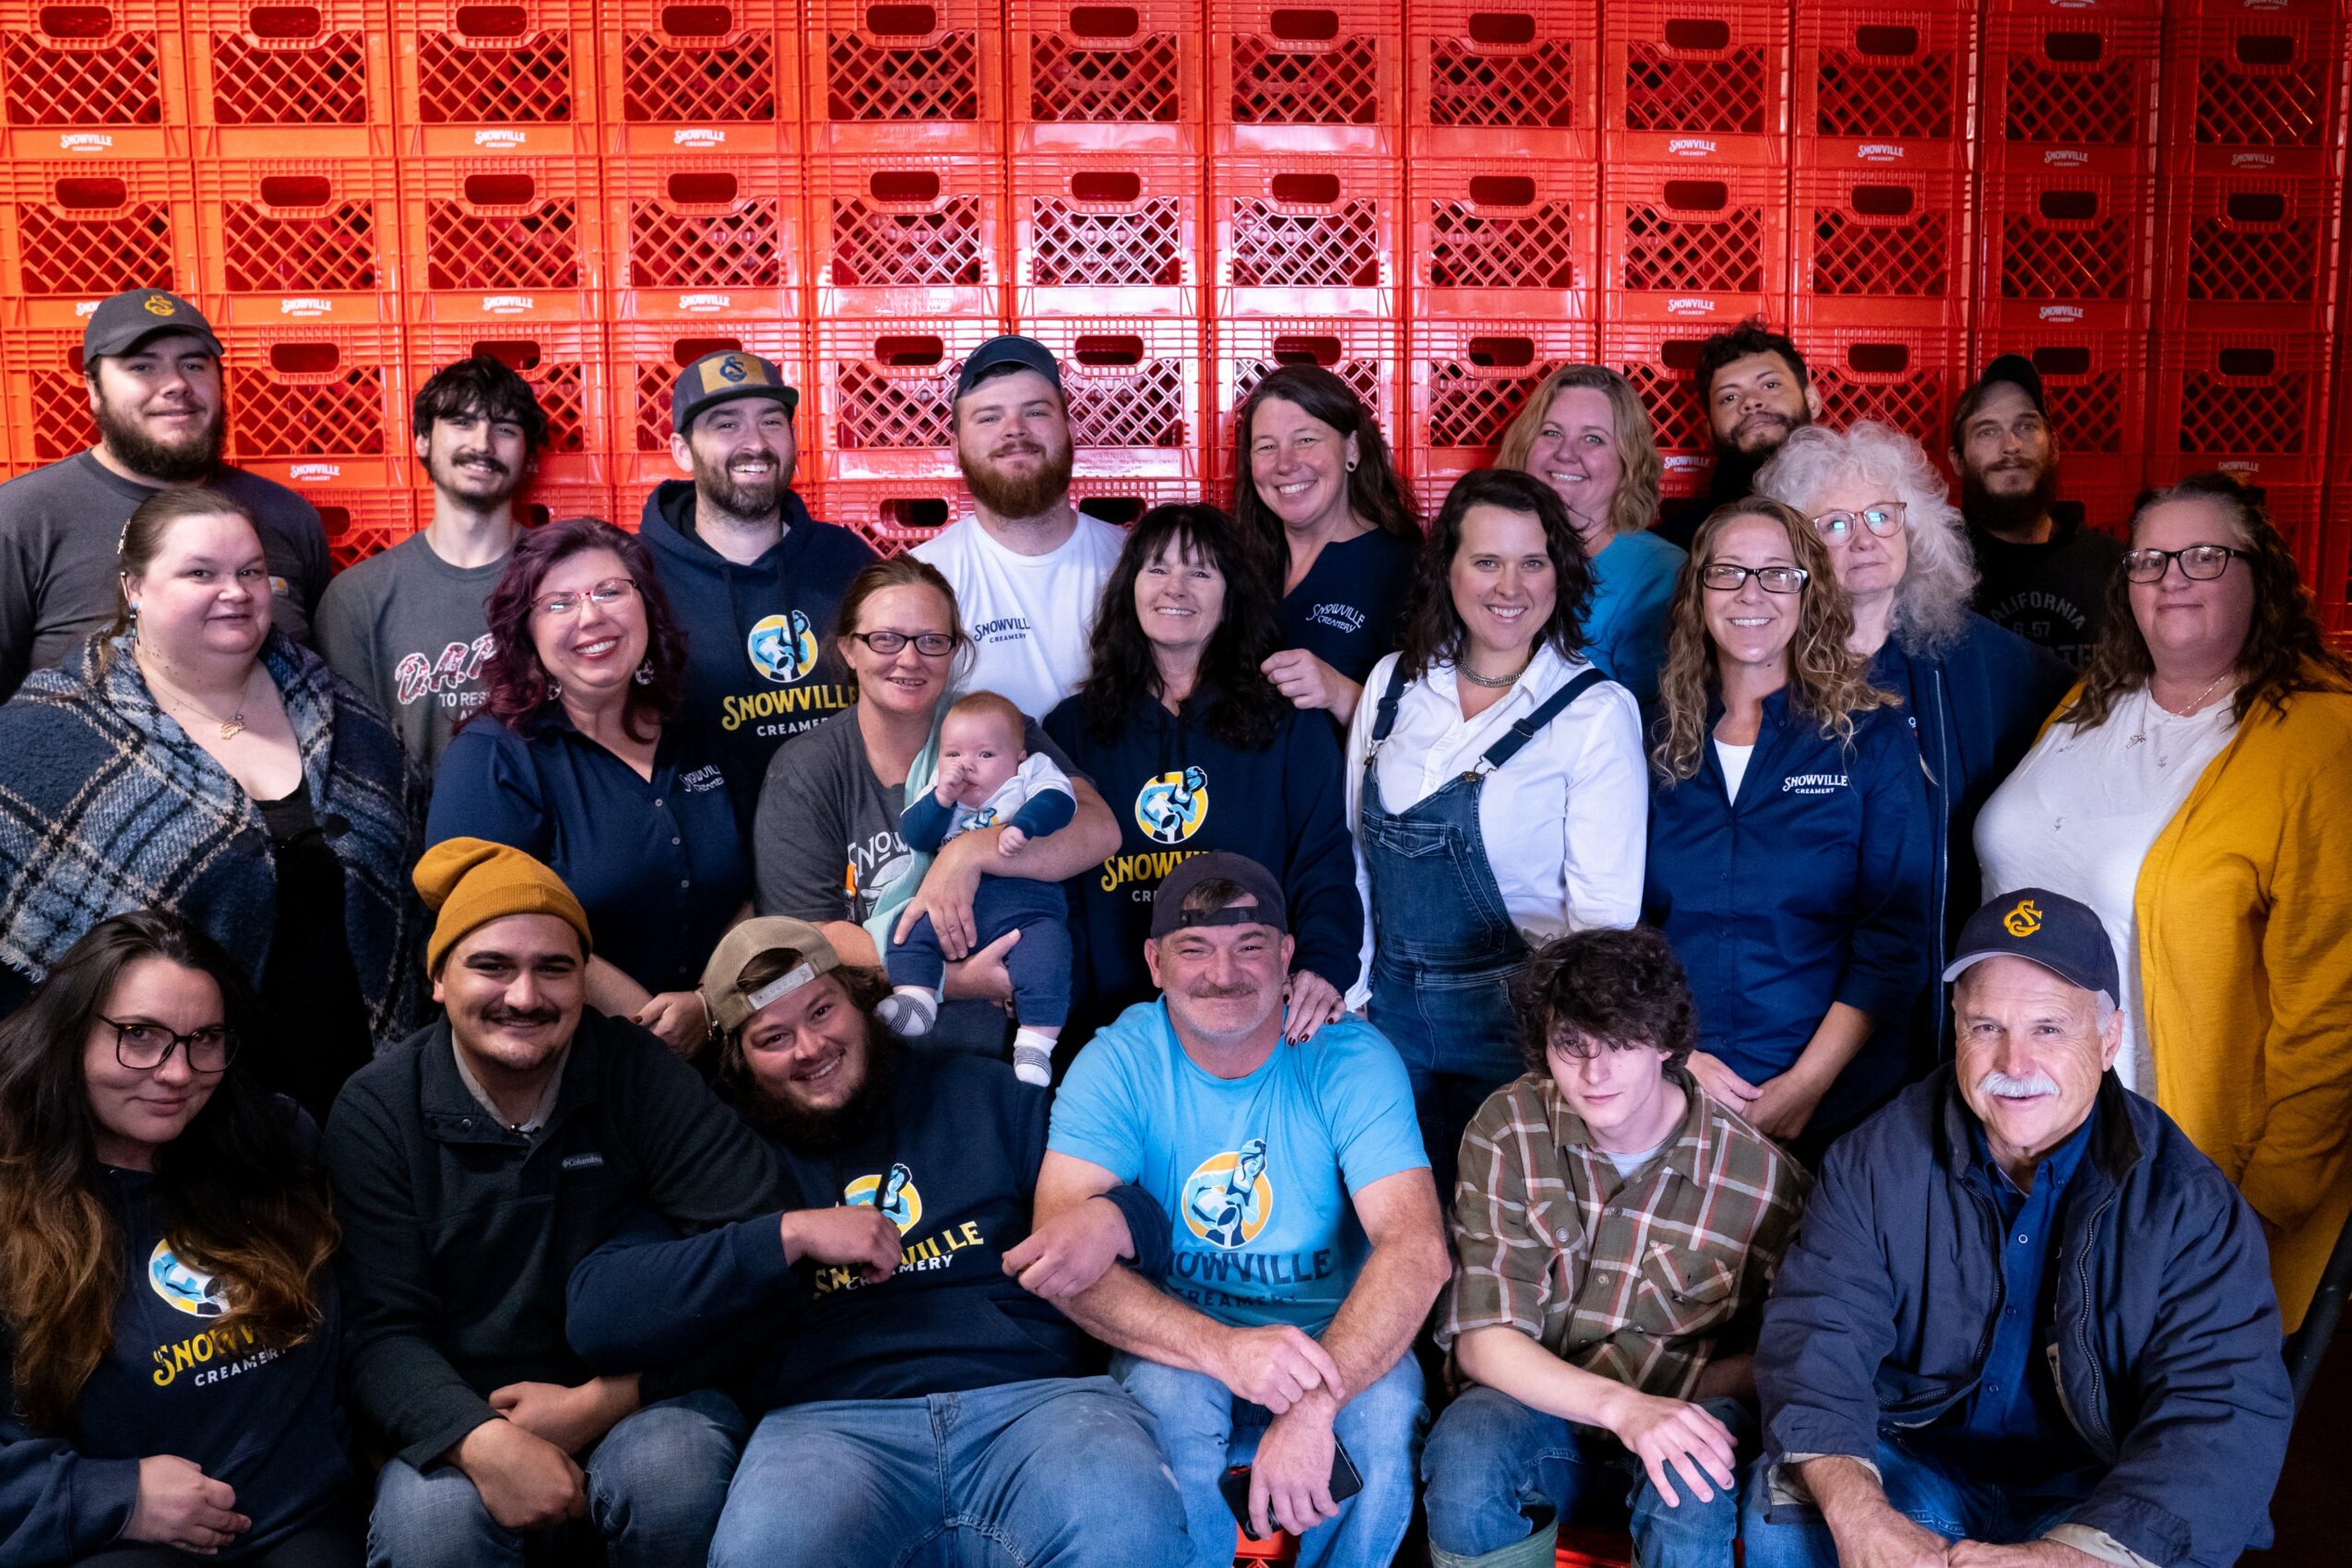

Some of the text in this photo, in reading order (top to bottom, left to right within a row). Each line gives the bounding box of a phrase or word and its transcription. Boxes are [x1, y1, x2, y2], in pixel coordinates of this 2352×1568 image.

[61, 134, 113, 148] SNOWVILLE
[475, 130, 526, 145] SNOWVILLE
[674, 129, 725, 144] SNOWVILLE
[1669, 139, 1716, 153] SNOWVILLE
[1858, 145, 1904, 158] SNOWVILLE
[2044, 150, 2088, 163] SNOWVILLE
[2231, 153, 2275, 166] SNOWVILLE
[281, 298, 332, 314] SNOWVILLE
[482, 296, 533, 311] SNOWVILLE
[679, 294, 730, 309] SNOWVILLE
[1668, 299, 1715, 312] SNOWVILLE
[2039, 305, 2084, 319] SNOWVILLE
[290, 464, 340, 479] SNOWVILLE
[1305, 603, 1365, 629] SNOWVILLE
[1990, 591, 2085, 630] ALIFORNIA
[974, 618, 1030, 642] SNOWVILL
[1317, 614, 1357, 634] CREAMERY
[989, 634, 1027, 643] CREAMERY
[438, 691, 491, 707] TO RES
[1782, 774, 1848, 792] SNOWVILLE
[847, 831, 909, 887] SNOW
[1100, 850, 1210, 892] SNOW
[195, 1347, 286, 1386] CREAMER
